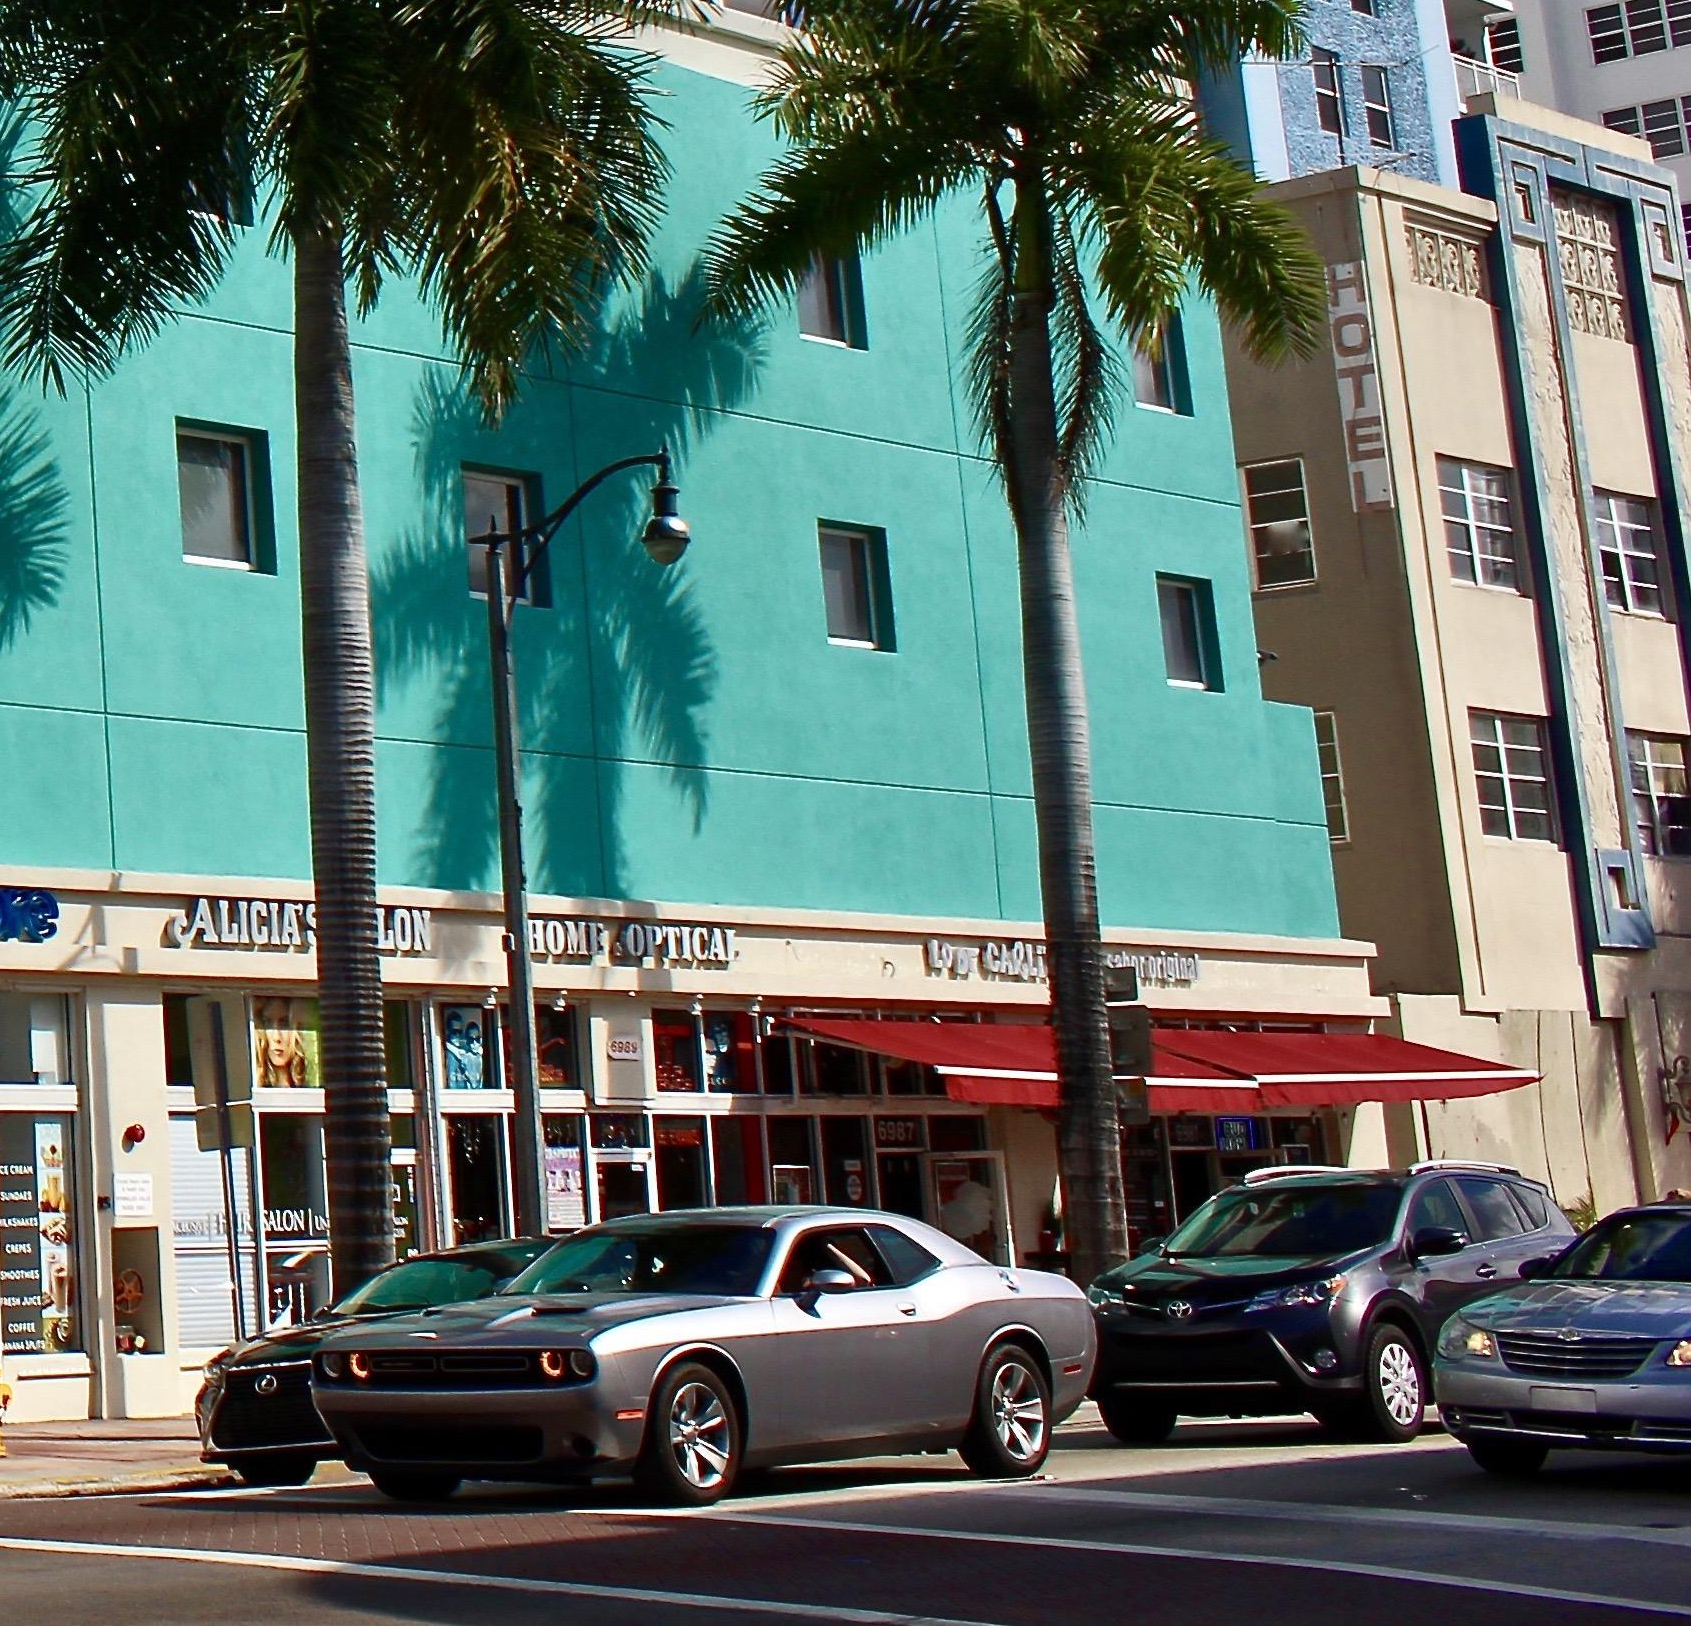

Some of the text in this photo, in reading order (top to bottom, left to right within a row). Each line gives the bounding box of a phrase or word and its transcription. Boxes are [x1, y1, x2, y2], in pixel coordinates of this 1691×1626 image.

[1326, 260, 1394, 513] HOTEL
[376, 907, 432, 953] LON
[528, 919, 739, 962] HOME OPTICAL
[927, 939, 953, 970] LO
[1148, 951, 1199, 982] original
[878, 1121, 915, 1142] 6987
[9, 1165, 34, 1175] CREAM
[0, 1191, 33, 1202] SUNDAES
[218, 1210, 254, 1235] HIR
[5, 1243, 32, 1254] CREPES
[0, 1270, 40, 1281] SMOOTHIES
[8, 1322, 36, 1333] COFFEE
